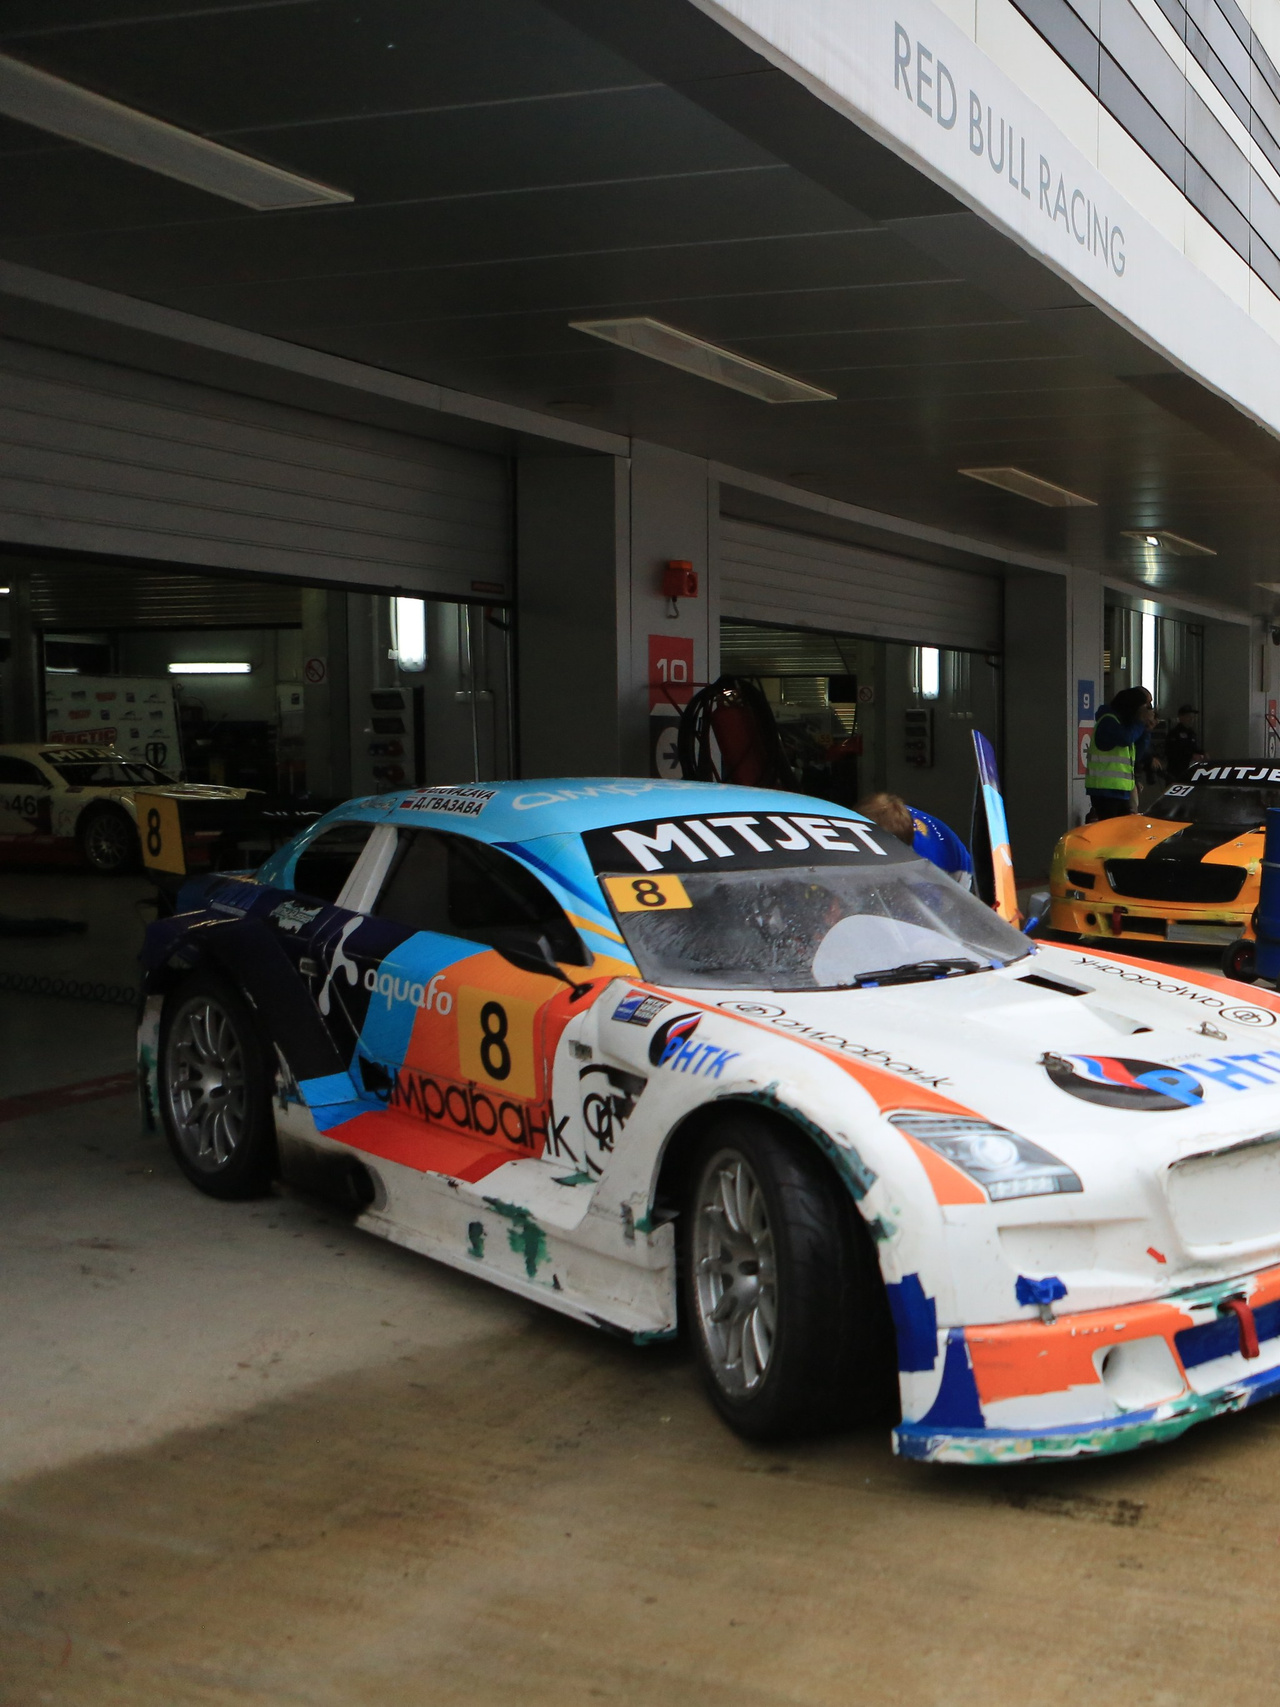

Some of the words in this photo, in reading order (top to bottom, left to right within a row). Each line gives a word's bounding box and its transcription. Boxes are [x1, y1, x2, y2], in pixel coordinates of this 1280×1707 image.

[894, 20, 957, 130] RED
[969, 88, 1031, 200] BULL
[1040, 154, 1126, 277] RACING
[656, 658, 688, 683] 10
[1083, 693, 1090, 709] 9
[11, 795, 36, 815] 46
[1170, 785, 1190, 796] 91
[412, 797, 483, 815] Д.ГВАЗАВА
[147, 808, 161, 857] 8
[611, 815, 888, 871] MITJET
[631, 878, 667, 908] 8
[364, 968, 453, 1015] aquafo
[479, 1000, 511, 1081] 8
